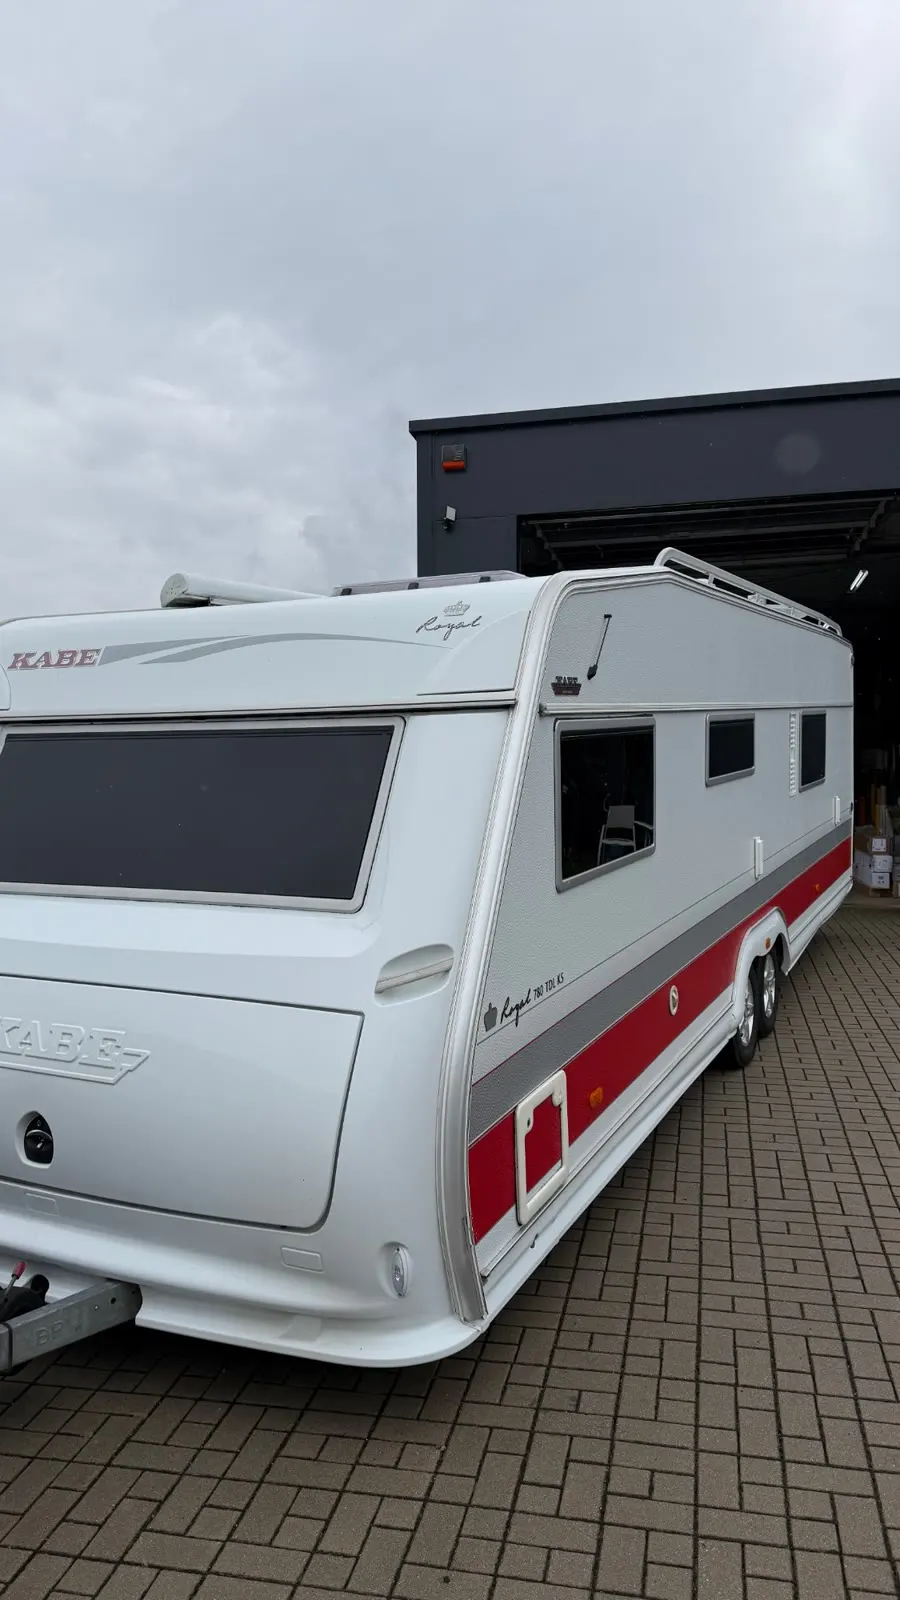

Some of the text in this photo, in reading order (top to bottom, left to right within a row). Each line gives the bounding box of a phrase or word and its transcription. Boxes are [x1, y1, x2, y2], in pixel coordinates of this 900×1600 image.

[416, 615, 482, 641] Royal
[7, 648, 102, 671] KABE
[500, 971, 564, 1028] Royal 780 TDL KS
